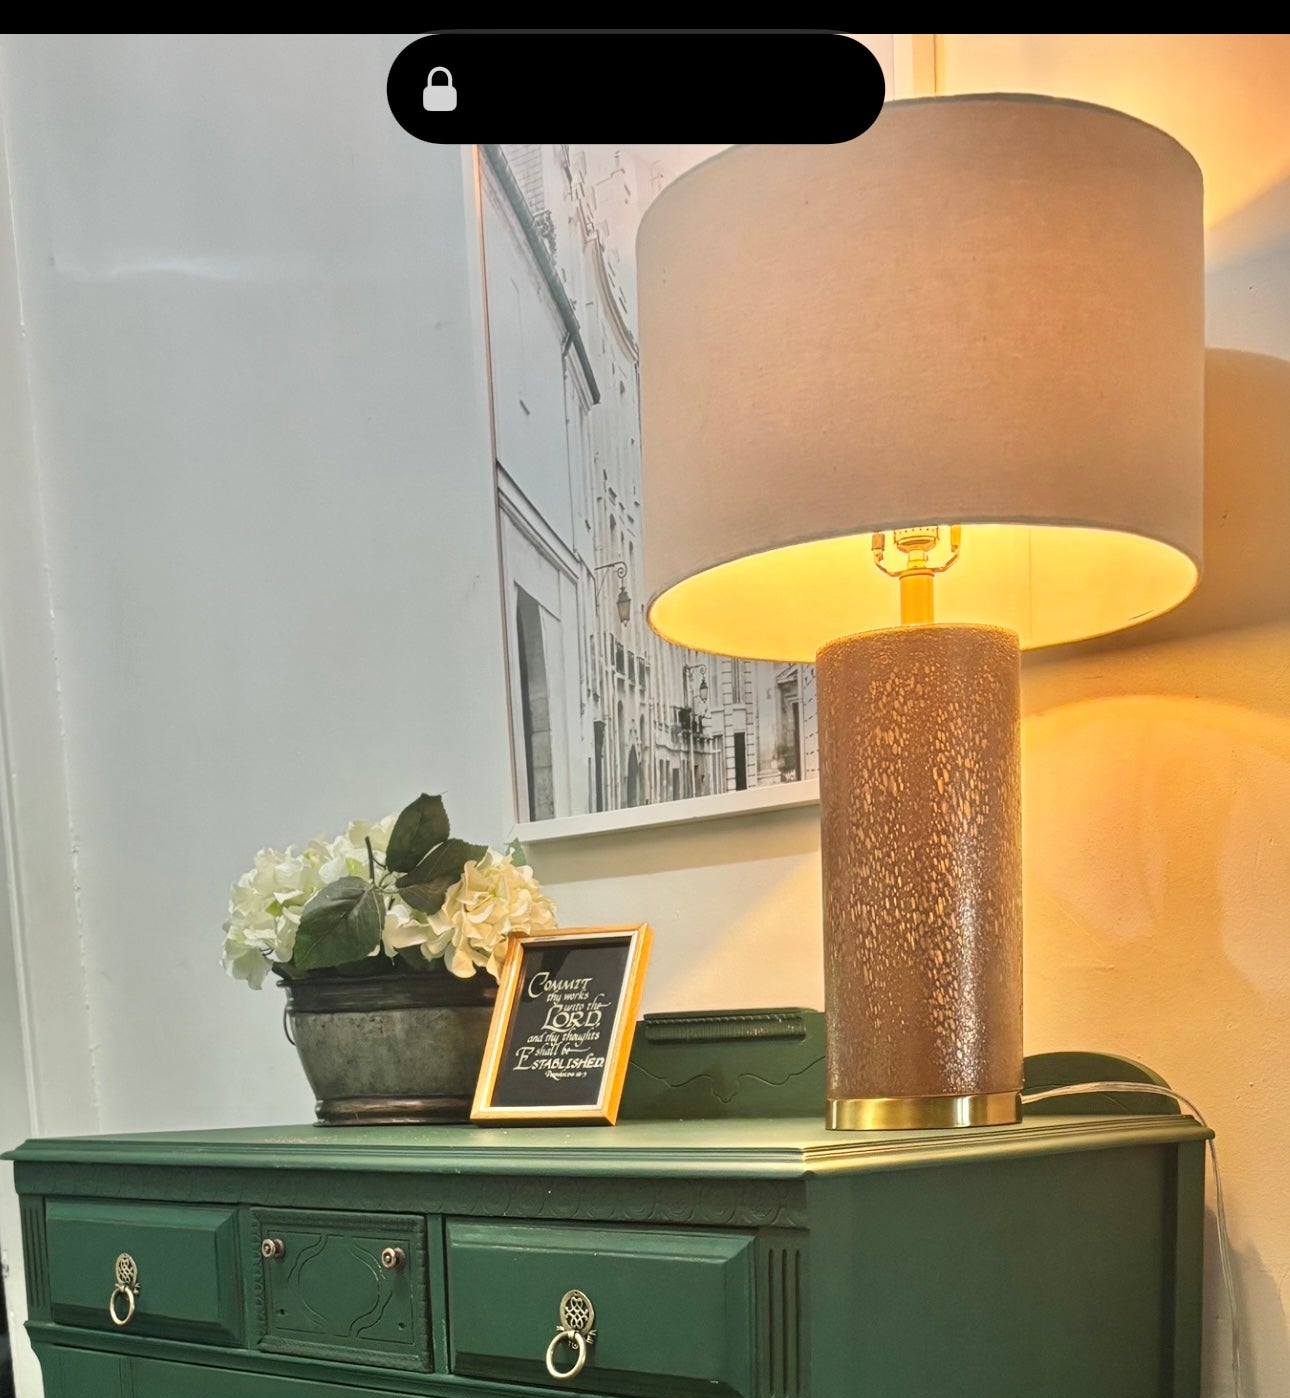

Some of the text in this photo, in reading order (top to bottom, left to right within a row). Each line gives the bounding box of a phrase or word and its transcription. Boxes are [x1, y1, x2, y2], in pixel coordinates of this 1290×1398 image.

[528, 972, 593, 998] COMMIT
[547, 991, 589, 1005] thy works
[563, 993, 611, 1011] unto the
[527, 1028, 600, 1047] and thy thoughts
[535, 1041, 563, 1056] shall
